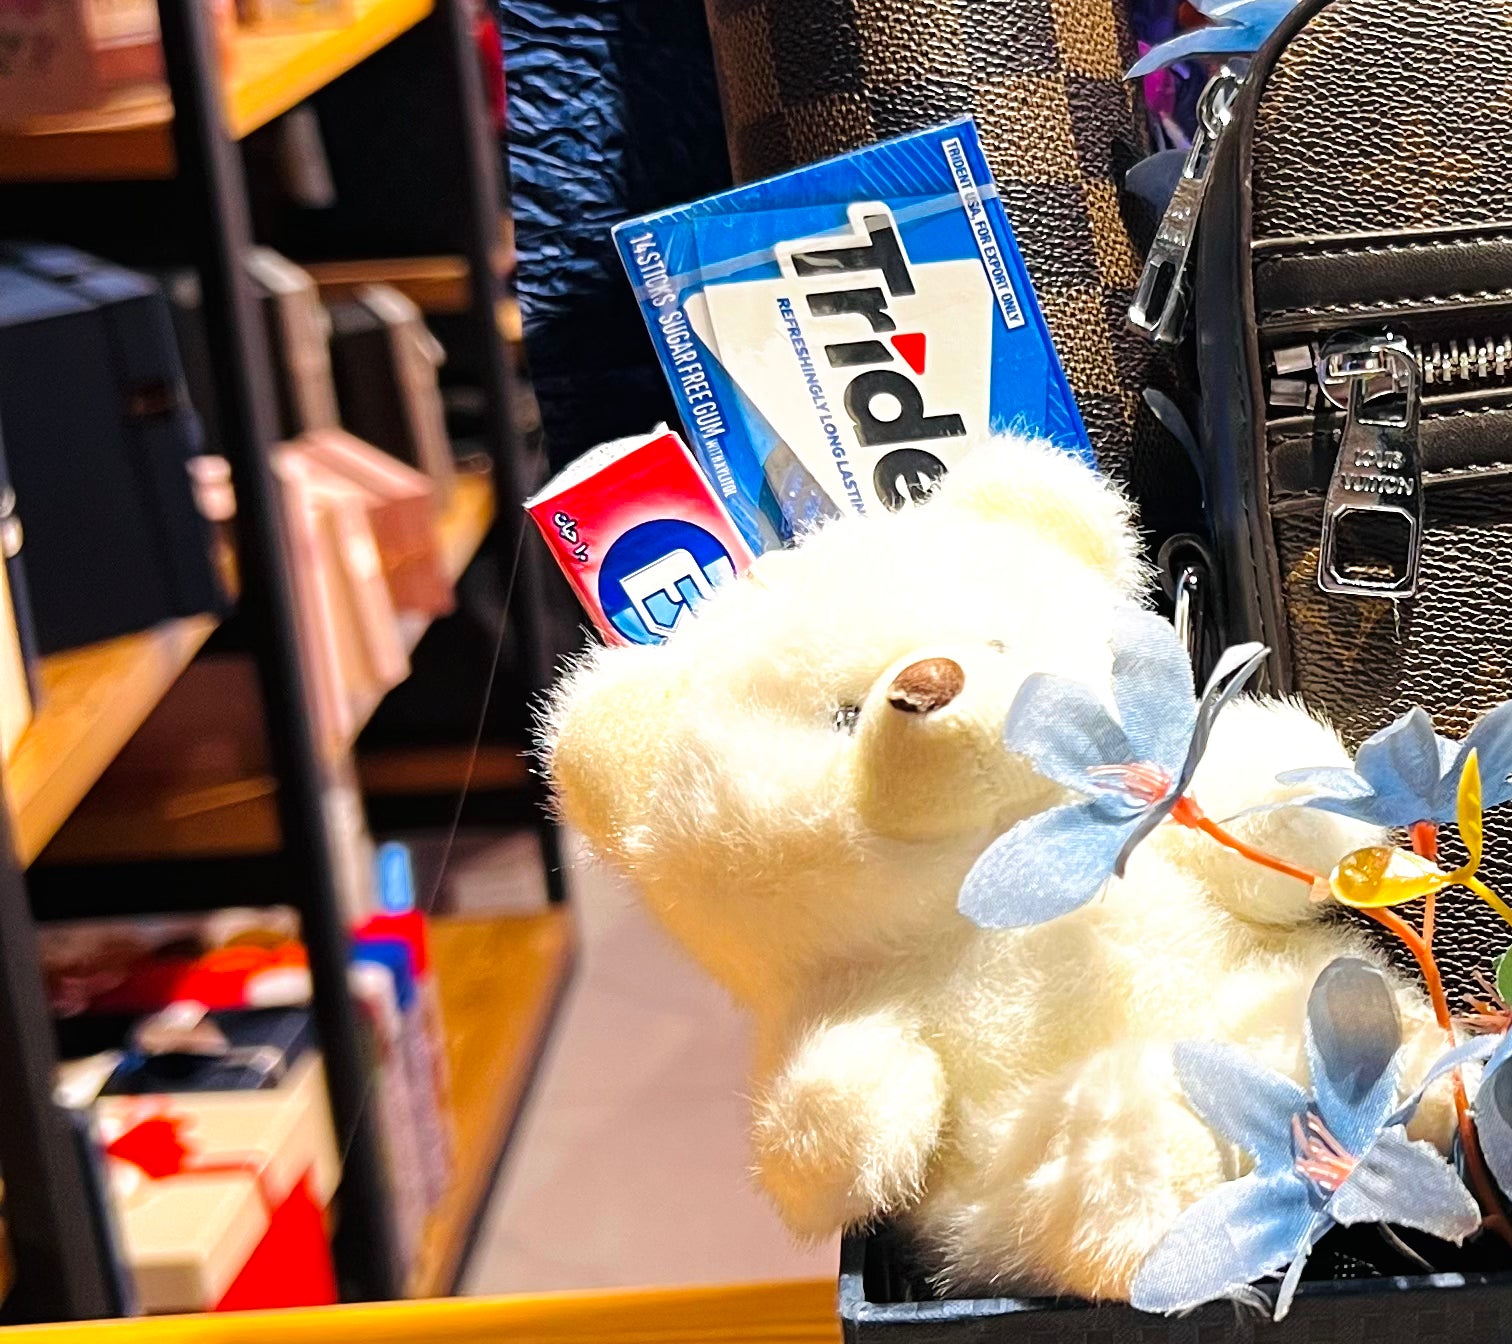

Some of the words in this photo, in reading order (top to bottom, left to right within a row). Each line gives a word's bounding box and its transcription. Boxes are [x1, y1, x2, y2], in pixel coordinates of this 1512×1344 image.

[946, 141, 974, 190] TRIDENT
[974, 220, 993, 245] FOR
[983, 246, 1011, 291] EXPORT
[1000, 293, 1022, 324] ONLY
[776, 297, 828, 413] REFRESHINGLY
[792, 212, 967, 514] Tride
[692, 400, 727, 440] GUM
[819, 409, 846, 464] LONG
[832, 459, 868, 518] LASTIN
